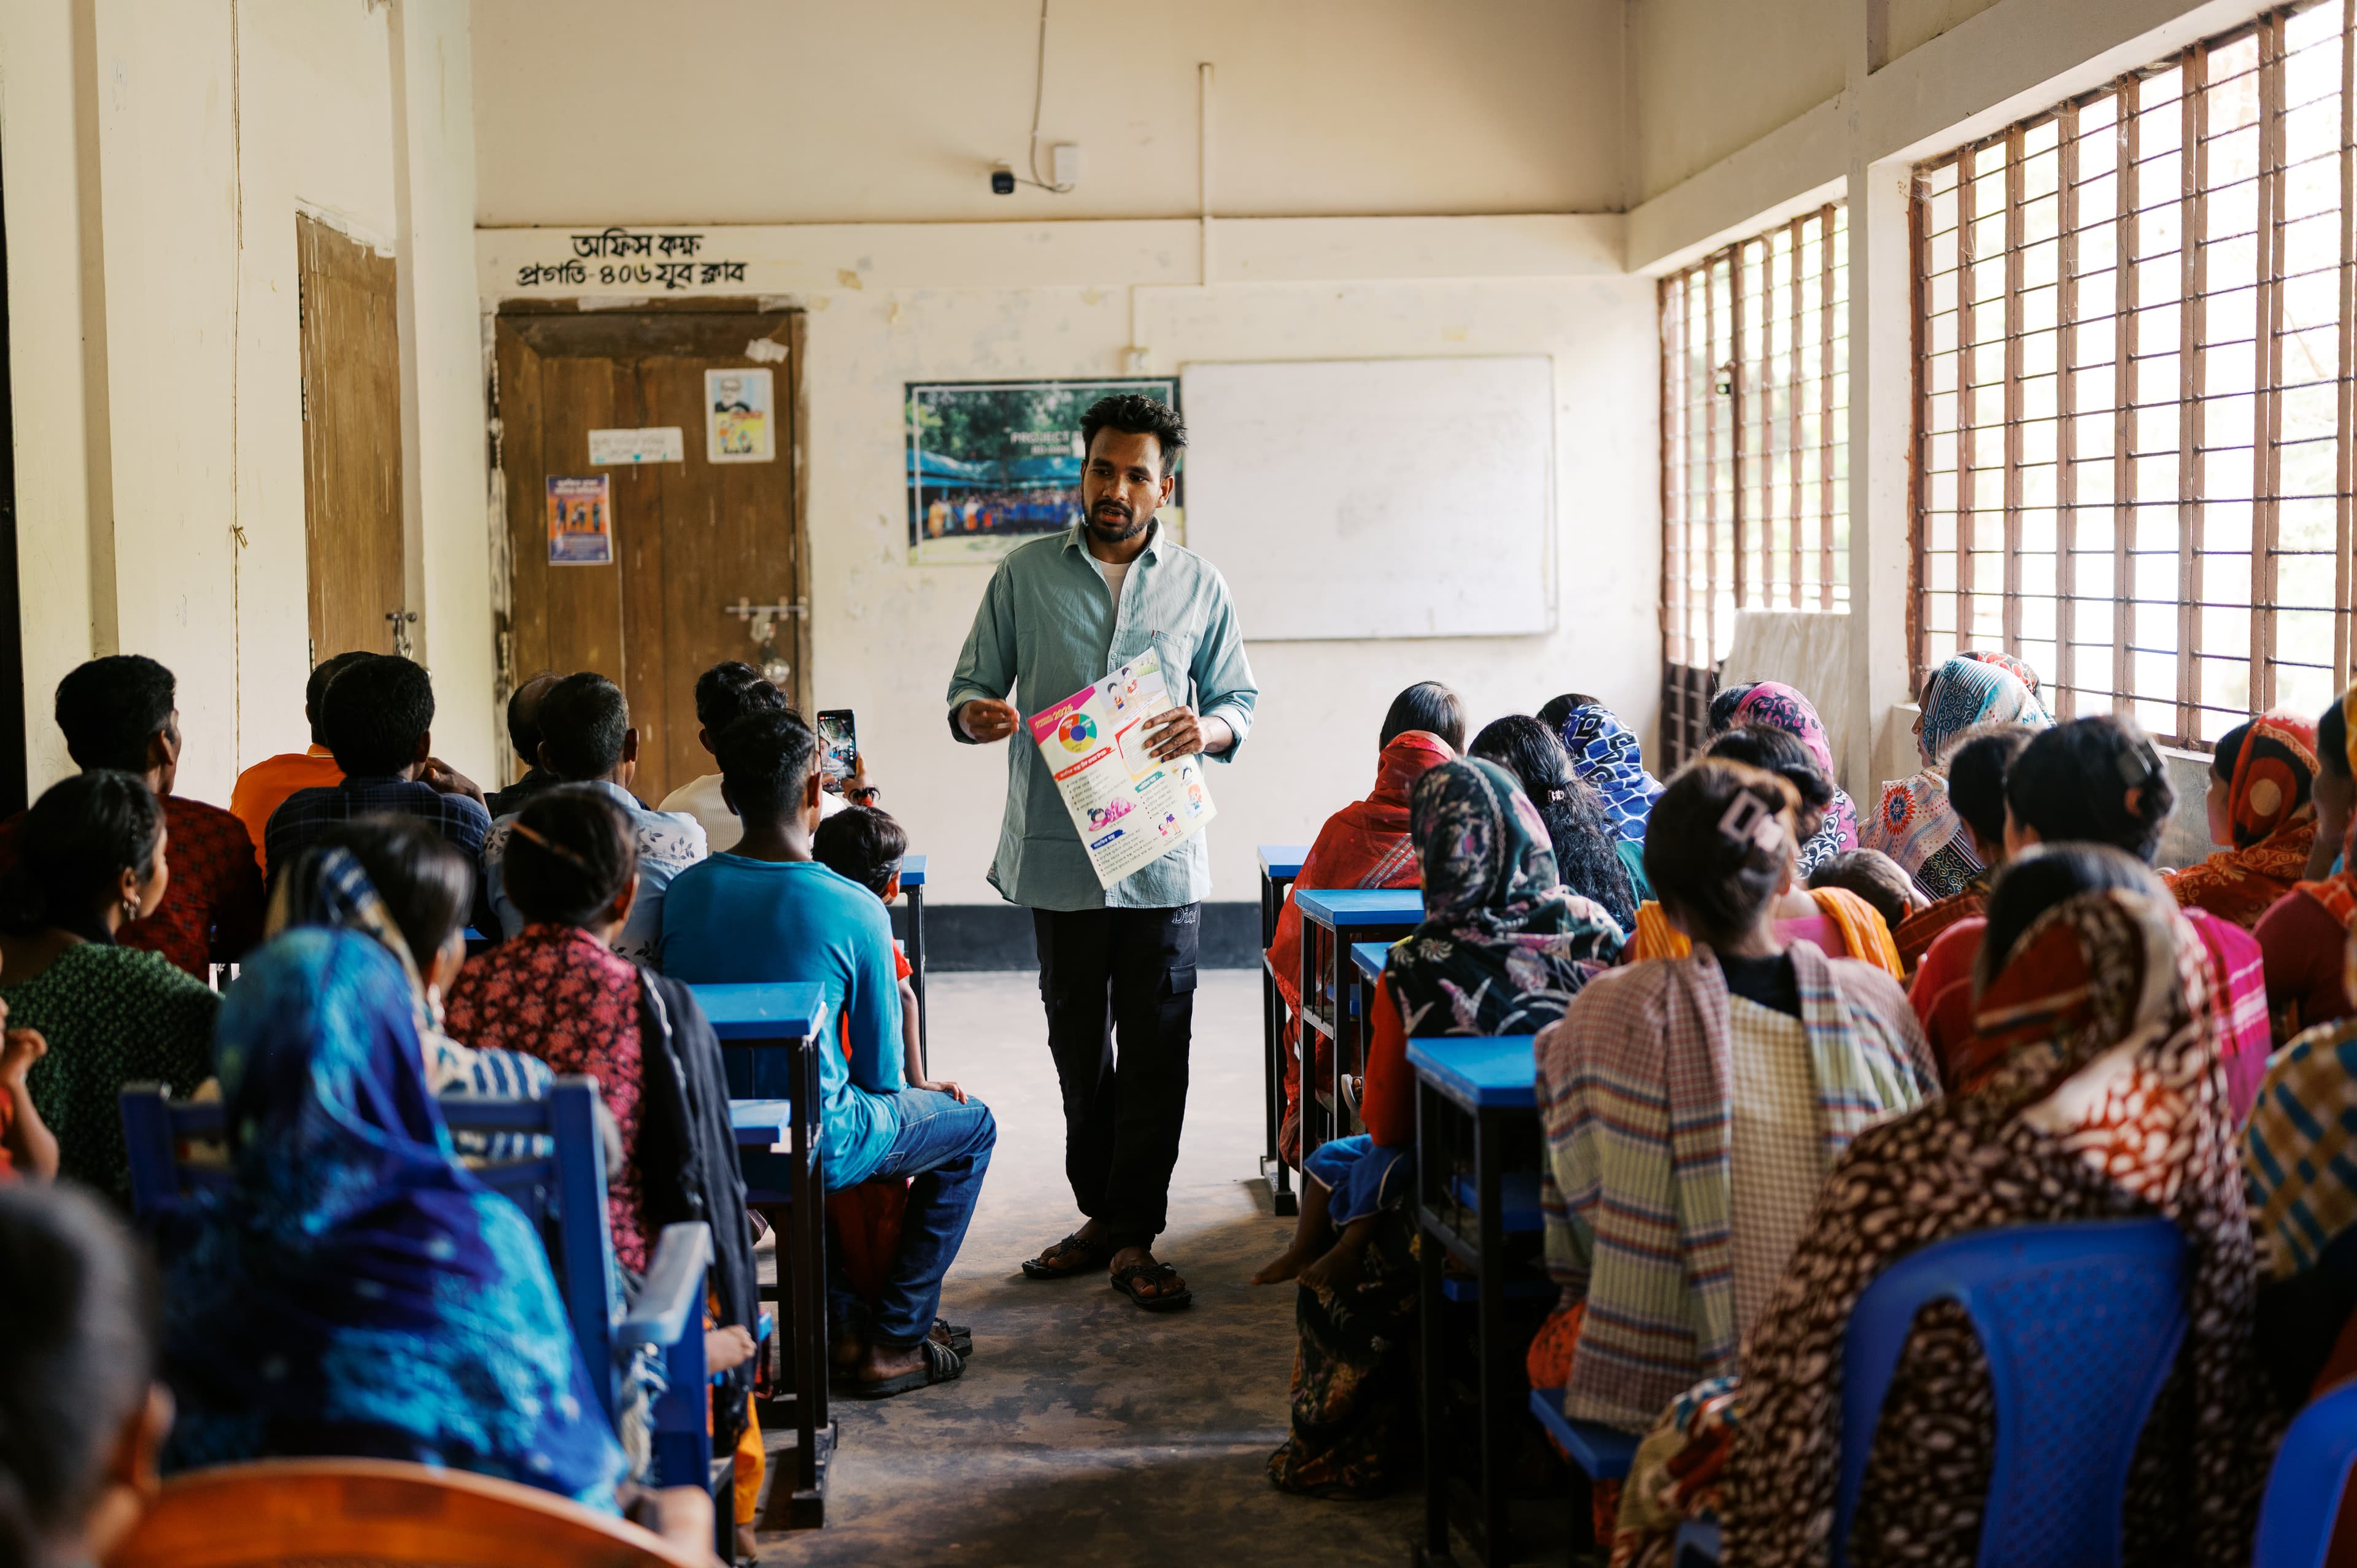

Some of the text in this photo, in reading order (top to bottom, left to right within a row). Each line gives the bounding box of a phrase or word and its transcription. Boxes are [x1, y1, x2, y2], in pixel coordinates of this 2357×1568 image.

[571, 228, 704, 257] অফিস কক্ষ
[656, 263, 695, 289] যুব
[700, 258, 748, 284] ক্লাব
[1172, 907, 1197, 924] Dior
